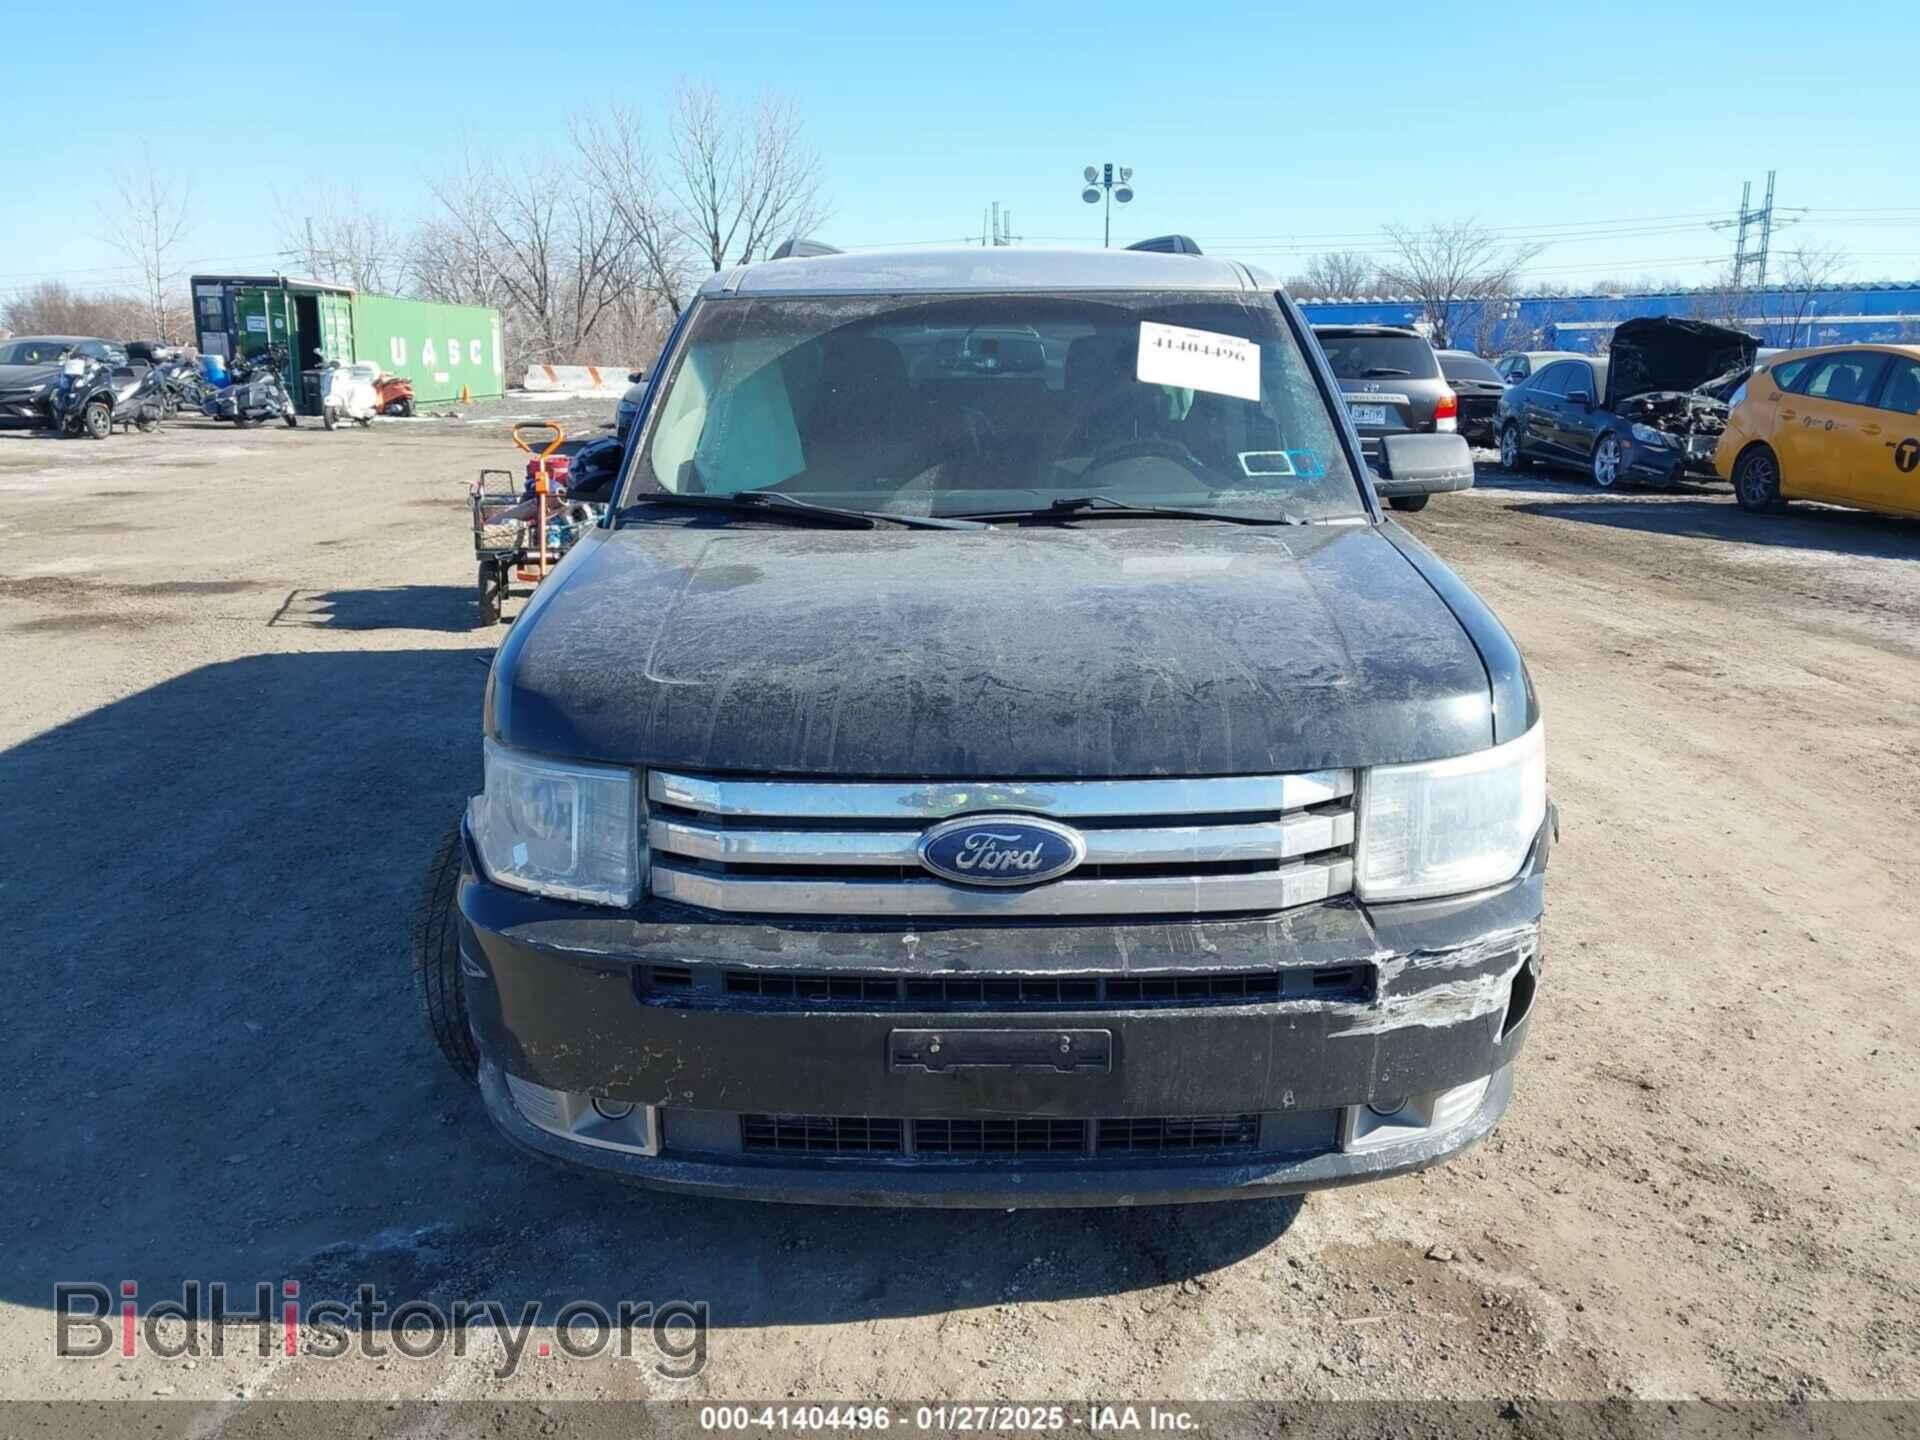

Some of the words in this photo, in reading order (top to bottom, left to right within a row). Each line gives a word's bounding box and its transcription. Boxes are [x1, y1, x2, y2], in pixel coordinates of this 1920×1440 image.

[390, 336, 482, 367] UASC
[1151, 337, 1247, 363] 41404496
[955, 831, 1043, 871] Ford
